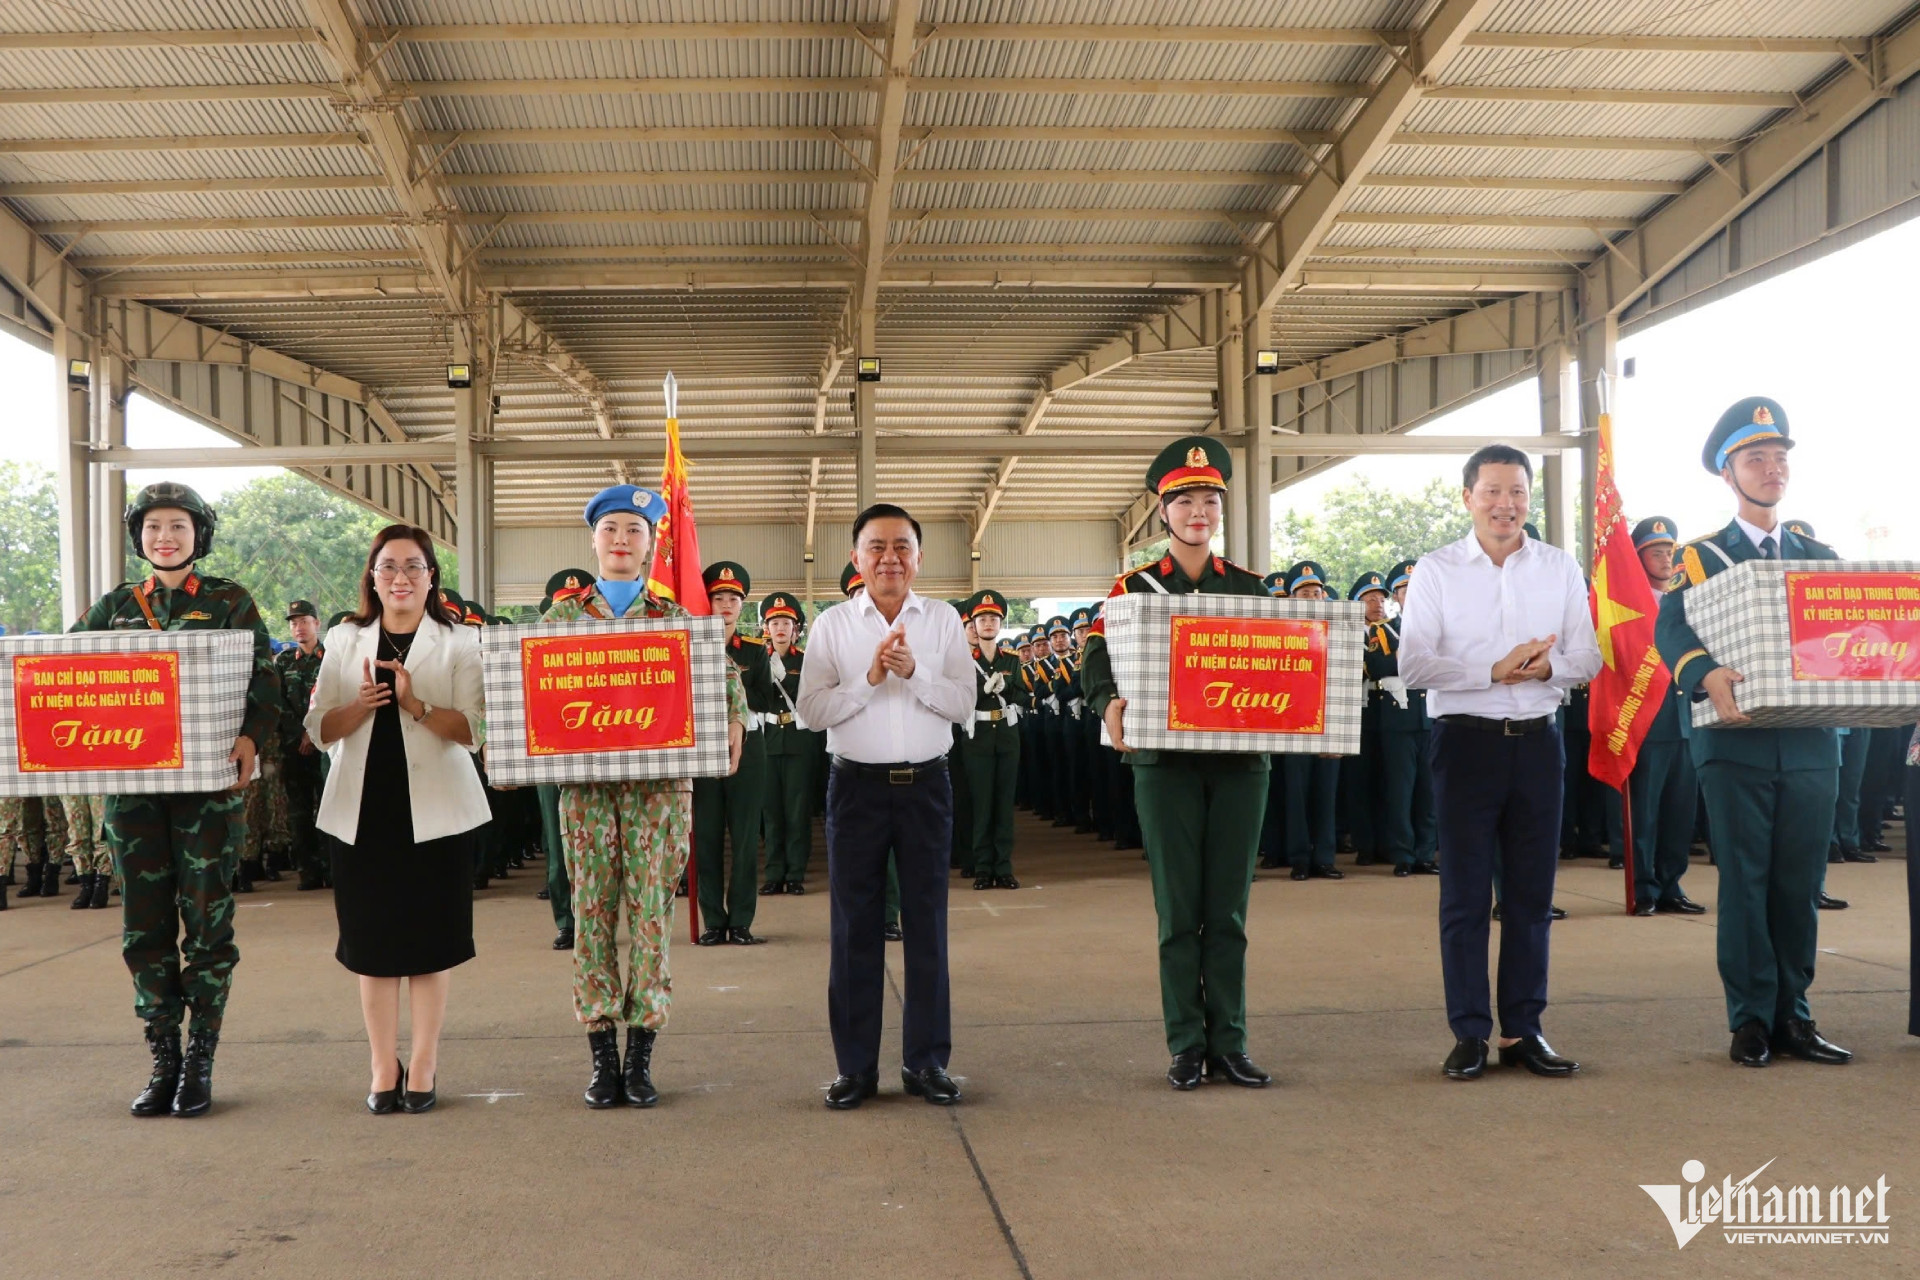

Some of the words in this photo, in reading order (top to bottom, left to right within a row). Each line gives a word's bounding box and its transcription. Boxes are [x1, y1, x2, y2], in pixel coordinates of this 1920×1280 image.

[1805, 587, 1824, 600] BAN
[1827, 584, 1841, 600] CHỈ
[1844, 587, 1862, 602] ĐẠO
[1864, 587, 1893, 600] TRUNG
[1895, 587, 1920, 600] ƯƠNG
[1818, 606, 1843, 623] NIỆM
[1846, 606, 1864, 620] CÁC
[1867, 607, 1891, 620] NGÀY
[1190, 633, 1209, 646] BAN
[1212, 630, 1228, 647] CHỈ
[1230, 634, 1249, 651] ĐẠO
[1252, 635, 1281, 649] TRUNG
[1284, 636, 1309, 650] ƯƠNG
[1823, 632, 1909, 662] Tặng
[543, 653, 564, 668] BAN
[567, 648, 582, 666] CHỈ
[585, 651, 605, 667] ĐẠO
[608, 649, 640, 664] TRUNG
[643, 647, 670, 662] ƯƠNG
[1185, 652, 1198, 668] KỶ
[1201, 654, 1226, 671] NIỆM
[1230, 655, 1248, 669] CÁC
[1252, 656, 1277, 670] NGÀY
[1280, 655, 1291, 671] LỄ
[1294, 658, 1312, 672] LỚN
[34, 672, 54, 685] BAN
[57, 667, 73, 685] CHỈ
[76, 671, 95, 687] ĐẠO
[98, 670, 130, 684] TRUNG
[133, 669, 159, 683] ƯƠNG
[540, 673, 553, 690] KỶ
[556, 674, 582, 691] NIỆM
[586, 672, 607, 687] CÁC
[610, 670, 637, 686] NGÀY
[641, 667, 652, 685] LỄ
[655, 668, 675, 683] LỚN
[31, 691, 43, 708] KỶ
[47, 692, 73, 710] NIỆM
[76, 692, 96, 707] CÁC
[100, 691, 127, 706] NGÀY
[130, 689, 141, 705] LỄ
[144, 690, 164, 705] LỚN
[1202, 681, 1292, 714] Tặng
[561, 701, 657, 732] Tặng
[51, 720, 146, 751] Tặng
